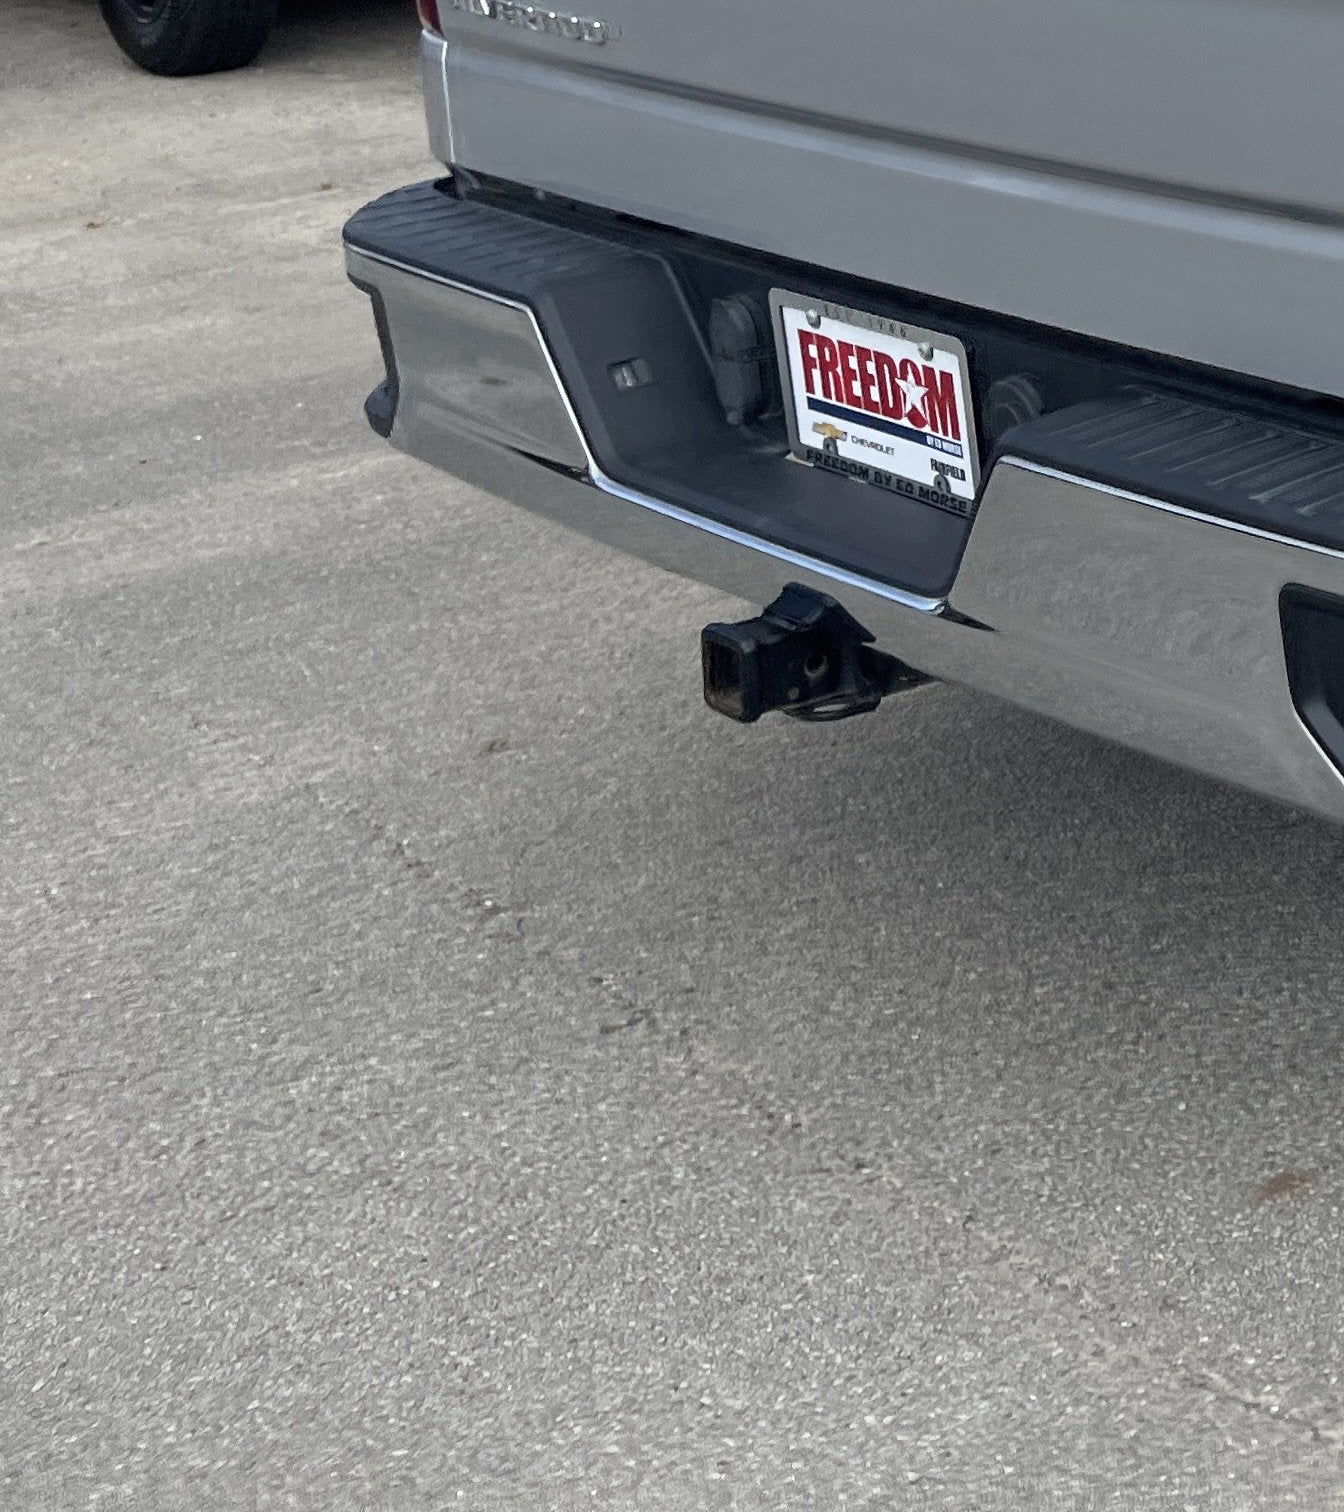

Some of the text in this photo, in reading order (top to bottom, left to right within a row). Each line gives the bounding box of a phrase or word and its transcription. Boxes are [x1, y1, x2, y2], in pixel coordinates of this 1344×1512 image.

[797, 328, 962, 442] FREEDOM
[851, 434, 895, 456] CHEVROLET
[806, 448, 968, 514] FREEDOM BY ED MORSE
